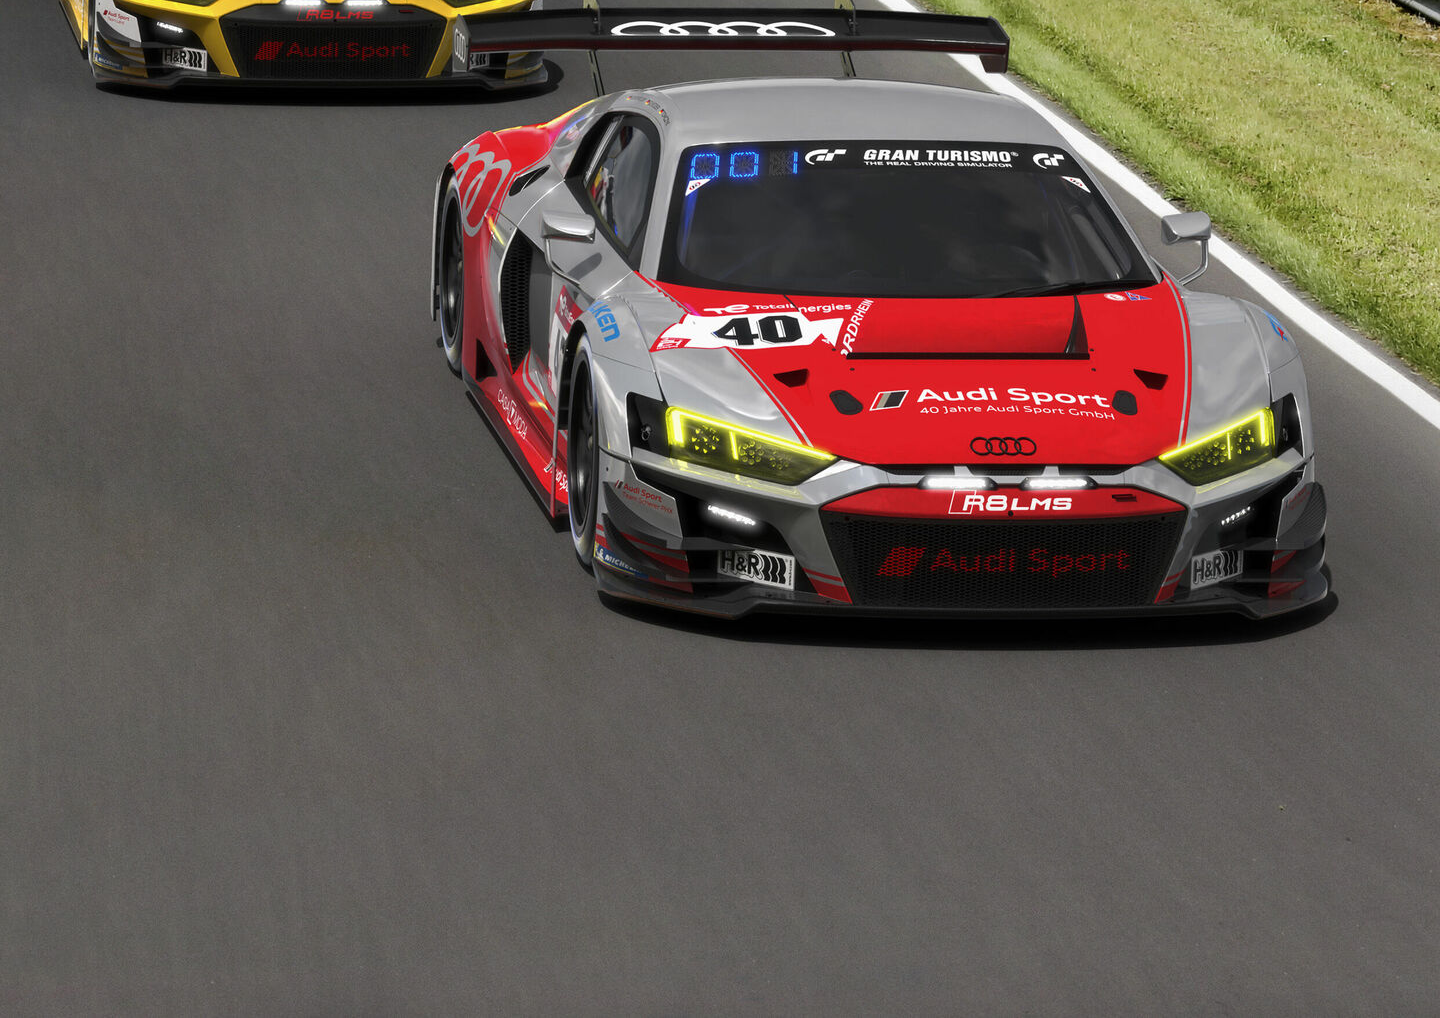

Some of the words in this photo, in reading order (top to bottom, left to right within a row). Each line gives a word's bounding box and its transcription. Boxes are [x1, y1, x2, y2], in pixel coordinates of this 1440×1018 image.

[164, 48, 188, 65] H&R
[286, 41, 339, 58] Audi
[346, 42, 411, 62] Sport
[863, 149, 920, 161] GRAN
[711, 315, 803, 346] 40
[916, 387, 995, 403] Audi
[1006, 388, 1110, 409] Sport
[920, 406, 939, 414] 40
[942, 405, 982, 414] Jahre
[986, 405, 1019, 413] Audi
[1023, 405, 1065, 416] Sport
[1069, 408, 1115, 421] GmbH
[624, 483, 640, 495] Audi
[640, 489, 662, 503] Sport
[1009, 496, 1073, 512] LMS
[721, 550, 761, 577] H&R
[930, 548, 1016, 572] Audi
[1027, 548, 1130, 579] Sport
[1193, 554, 1222, 584] H&R
